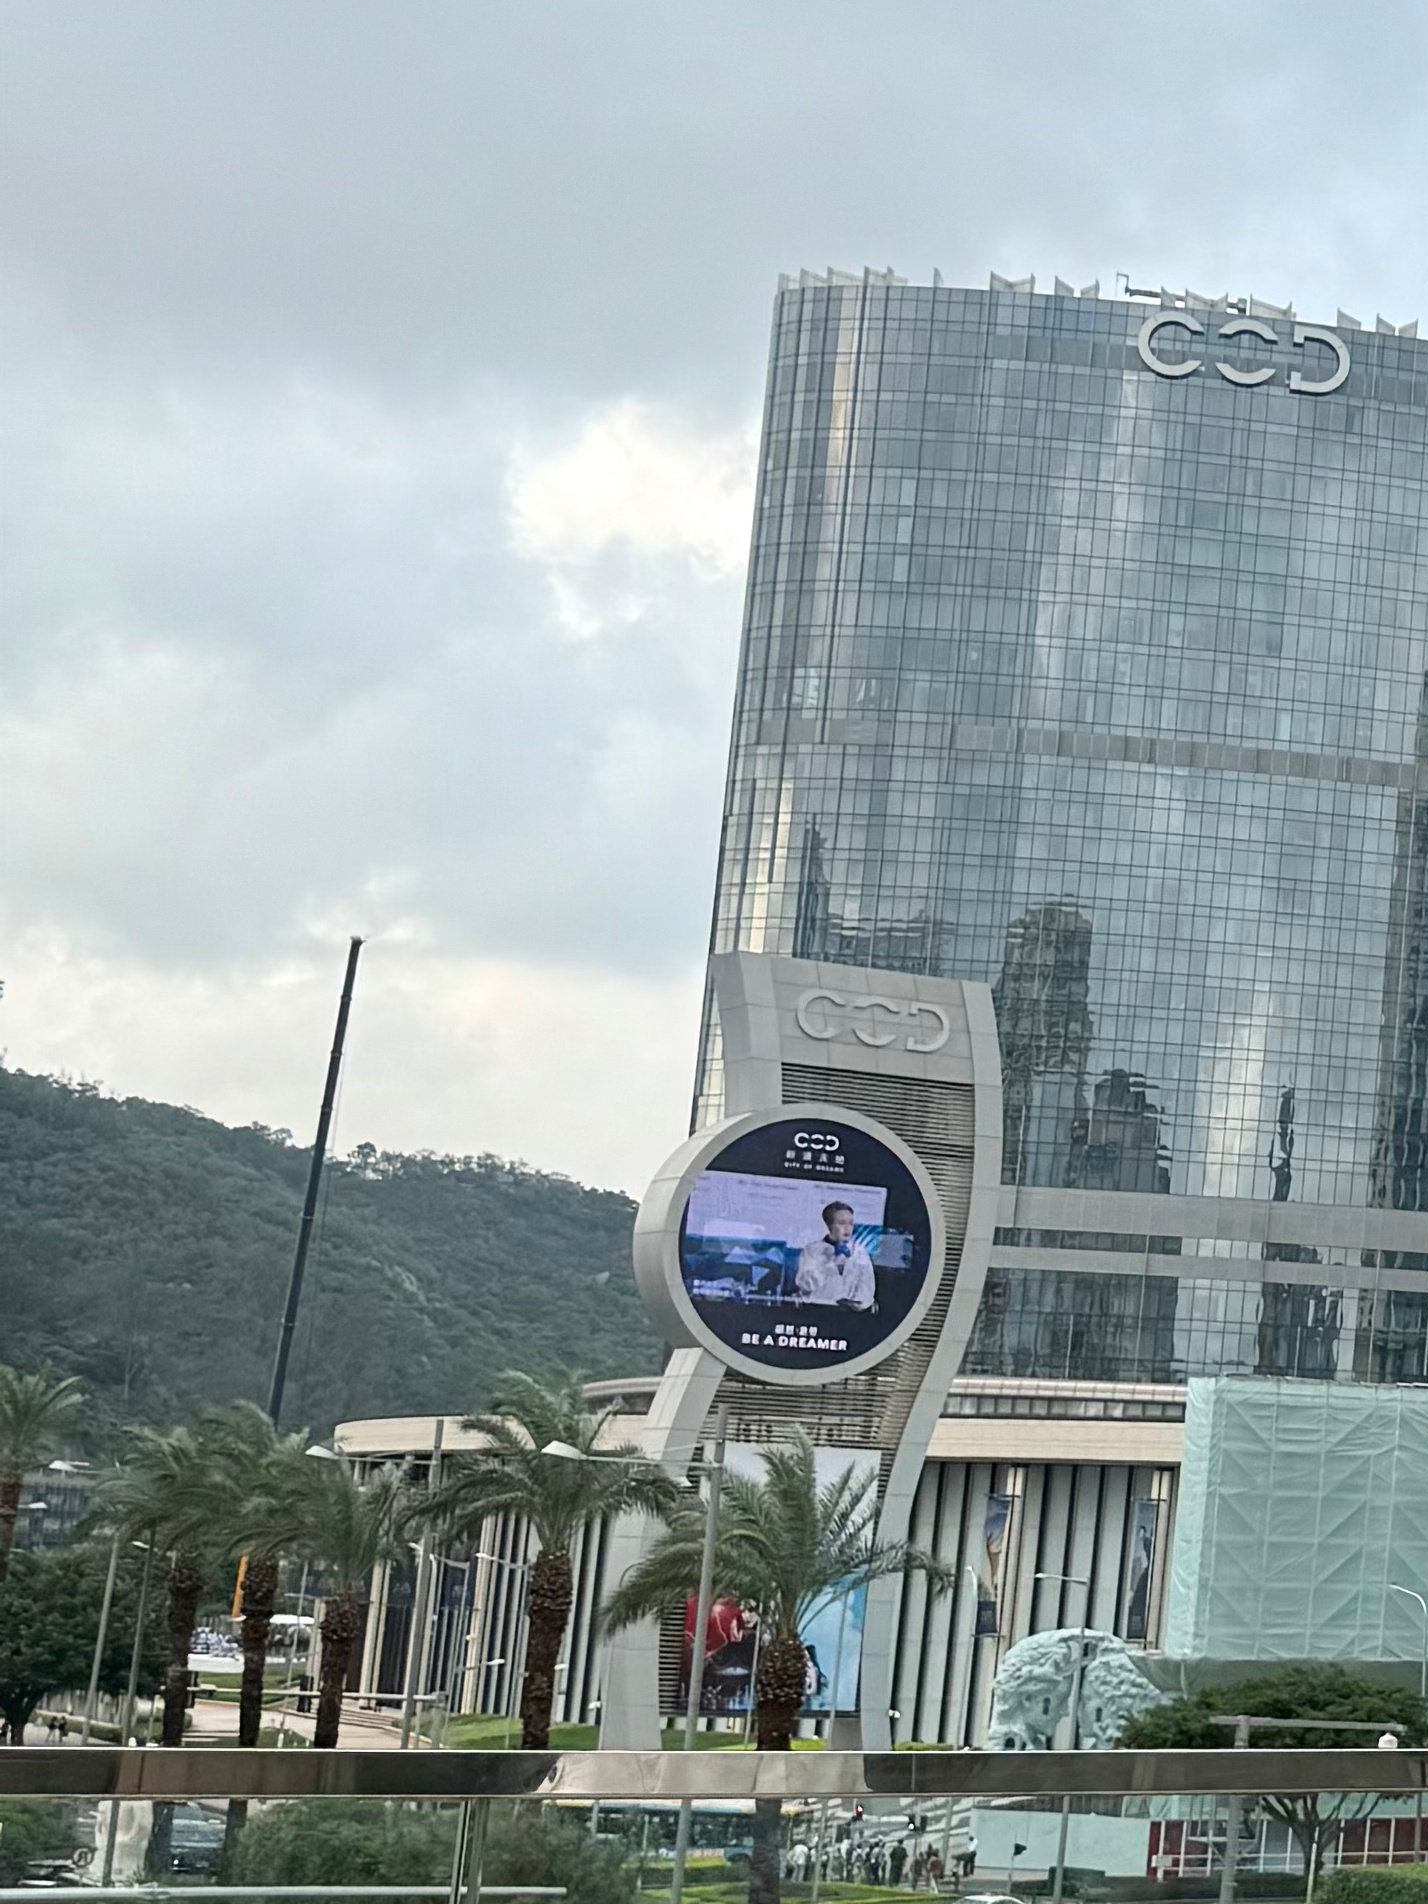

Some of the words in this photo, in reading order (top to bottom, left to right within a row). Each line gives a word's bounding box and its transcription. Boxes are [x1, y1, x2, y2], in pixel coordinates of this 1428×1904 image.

[742, 1333, 760, 1345] BE
[763, 1334, 774, 1345] A
[778, 1336, 848, 1351] DREAMER
